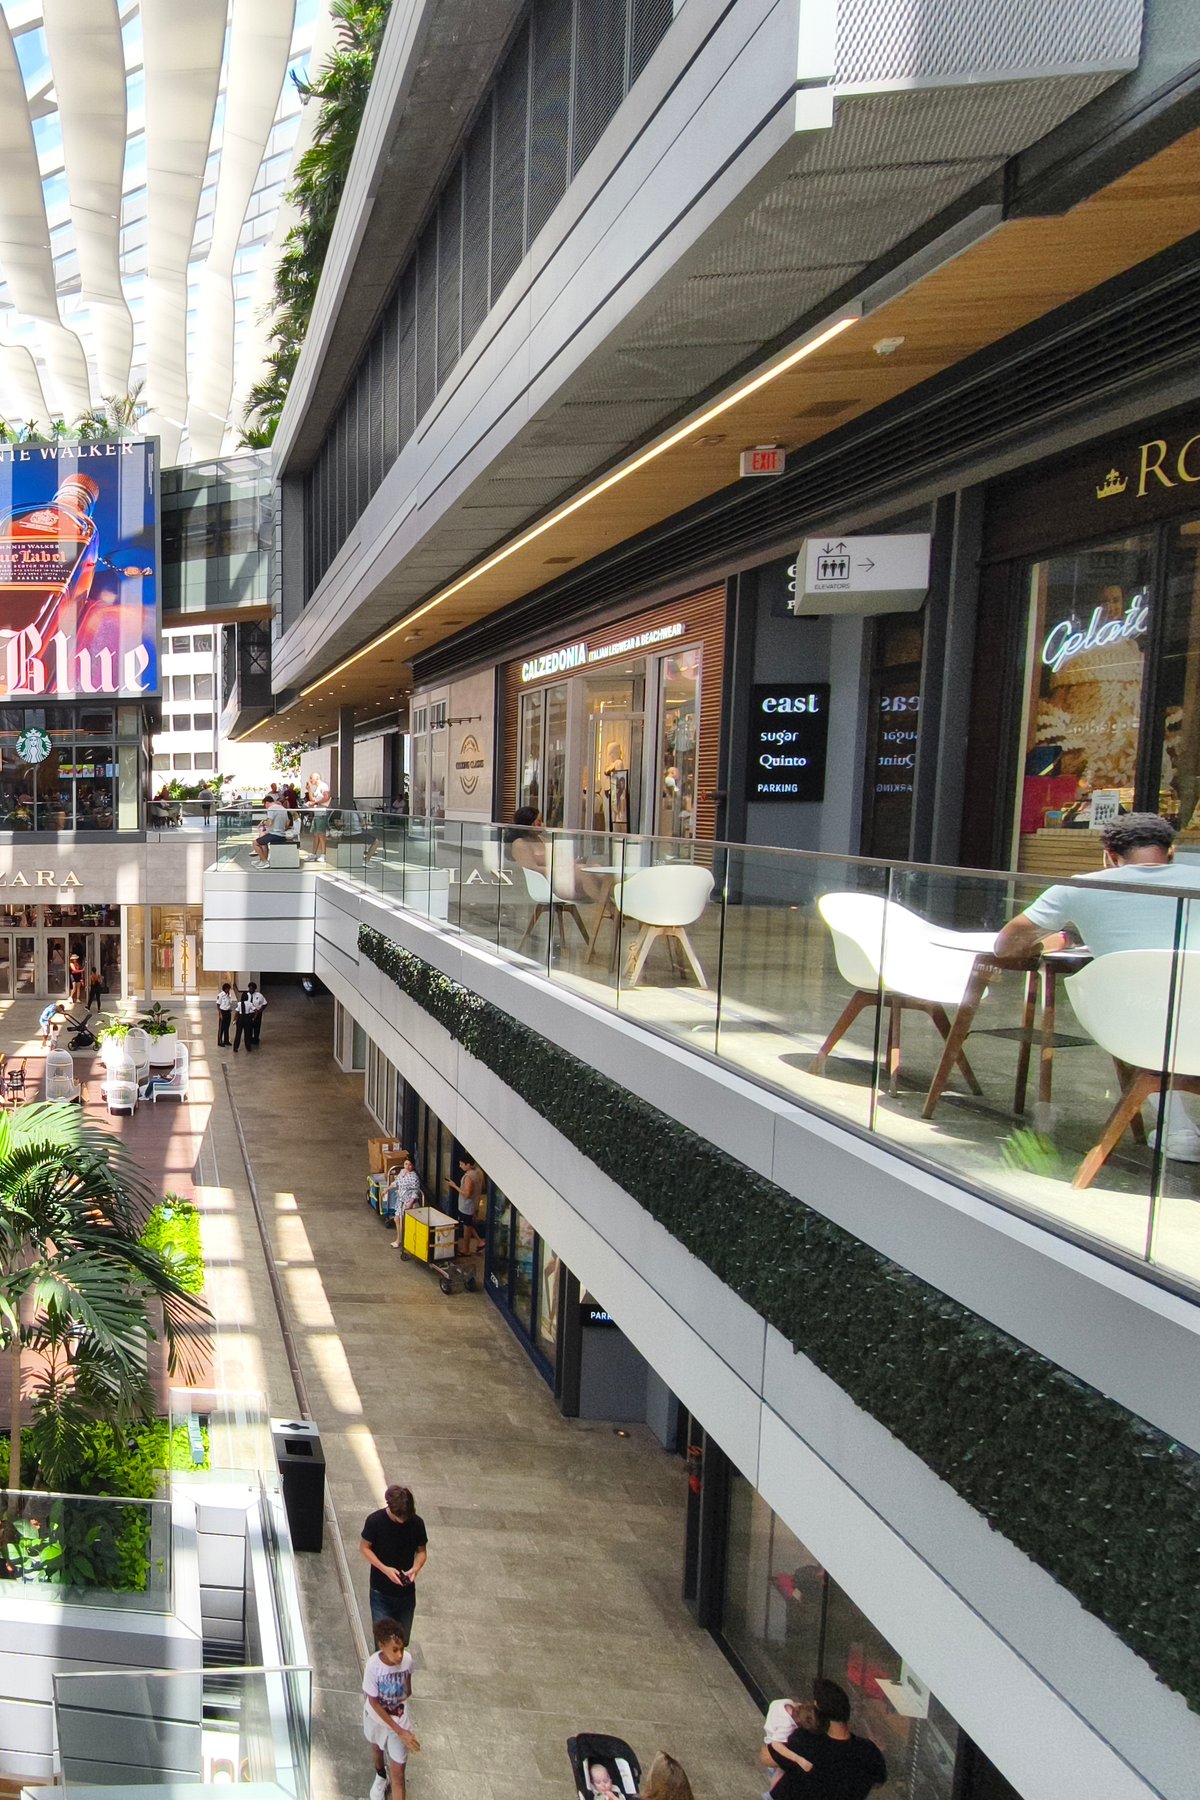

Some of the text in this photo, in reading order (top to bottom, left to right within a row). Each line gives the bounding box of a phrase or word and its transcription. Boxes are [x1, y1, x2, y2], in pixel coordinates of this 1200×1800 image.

[41, 443, 134, 459] WALKER
[752, 450, 778, 472] EXIT
[20, 549, 67, 563] Label
[522, 643, 587, 682] CALZEDONIA
[640, 623, 682, 645] BEACHWEAR
[762, 694, 820, 713] east
[760, 730, 798, 746] sugar
[759, 753, 808, 770] Quinto
[758, 784, 798, 793] PARKING
